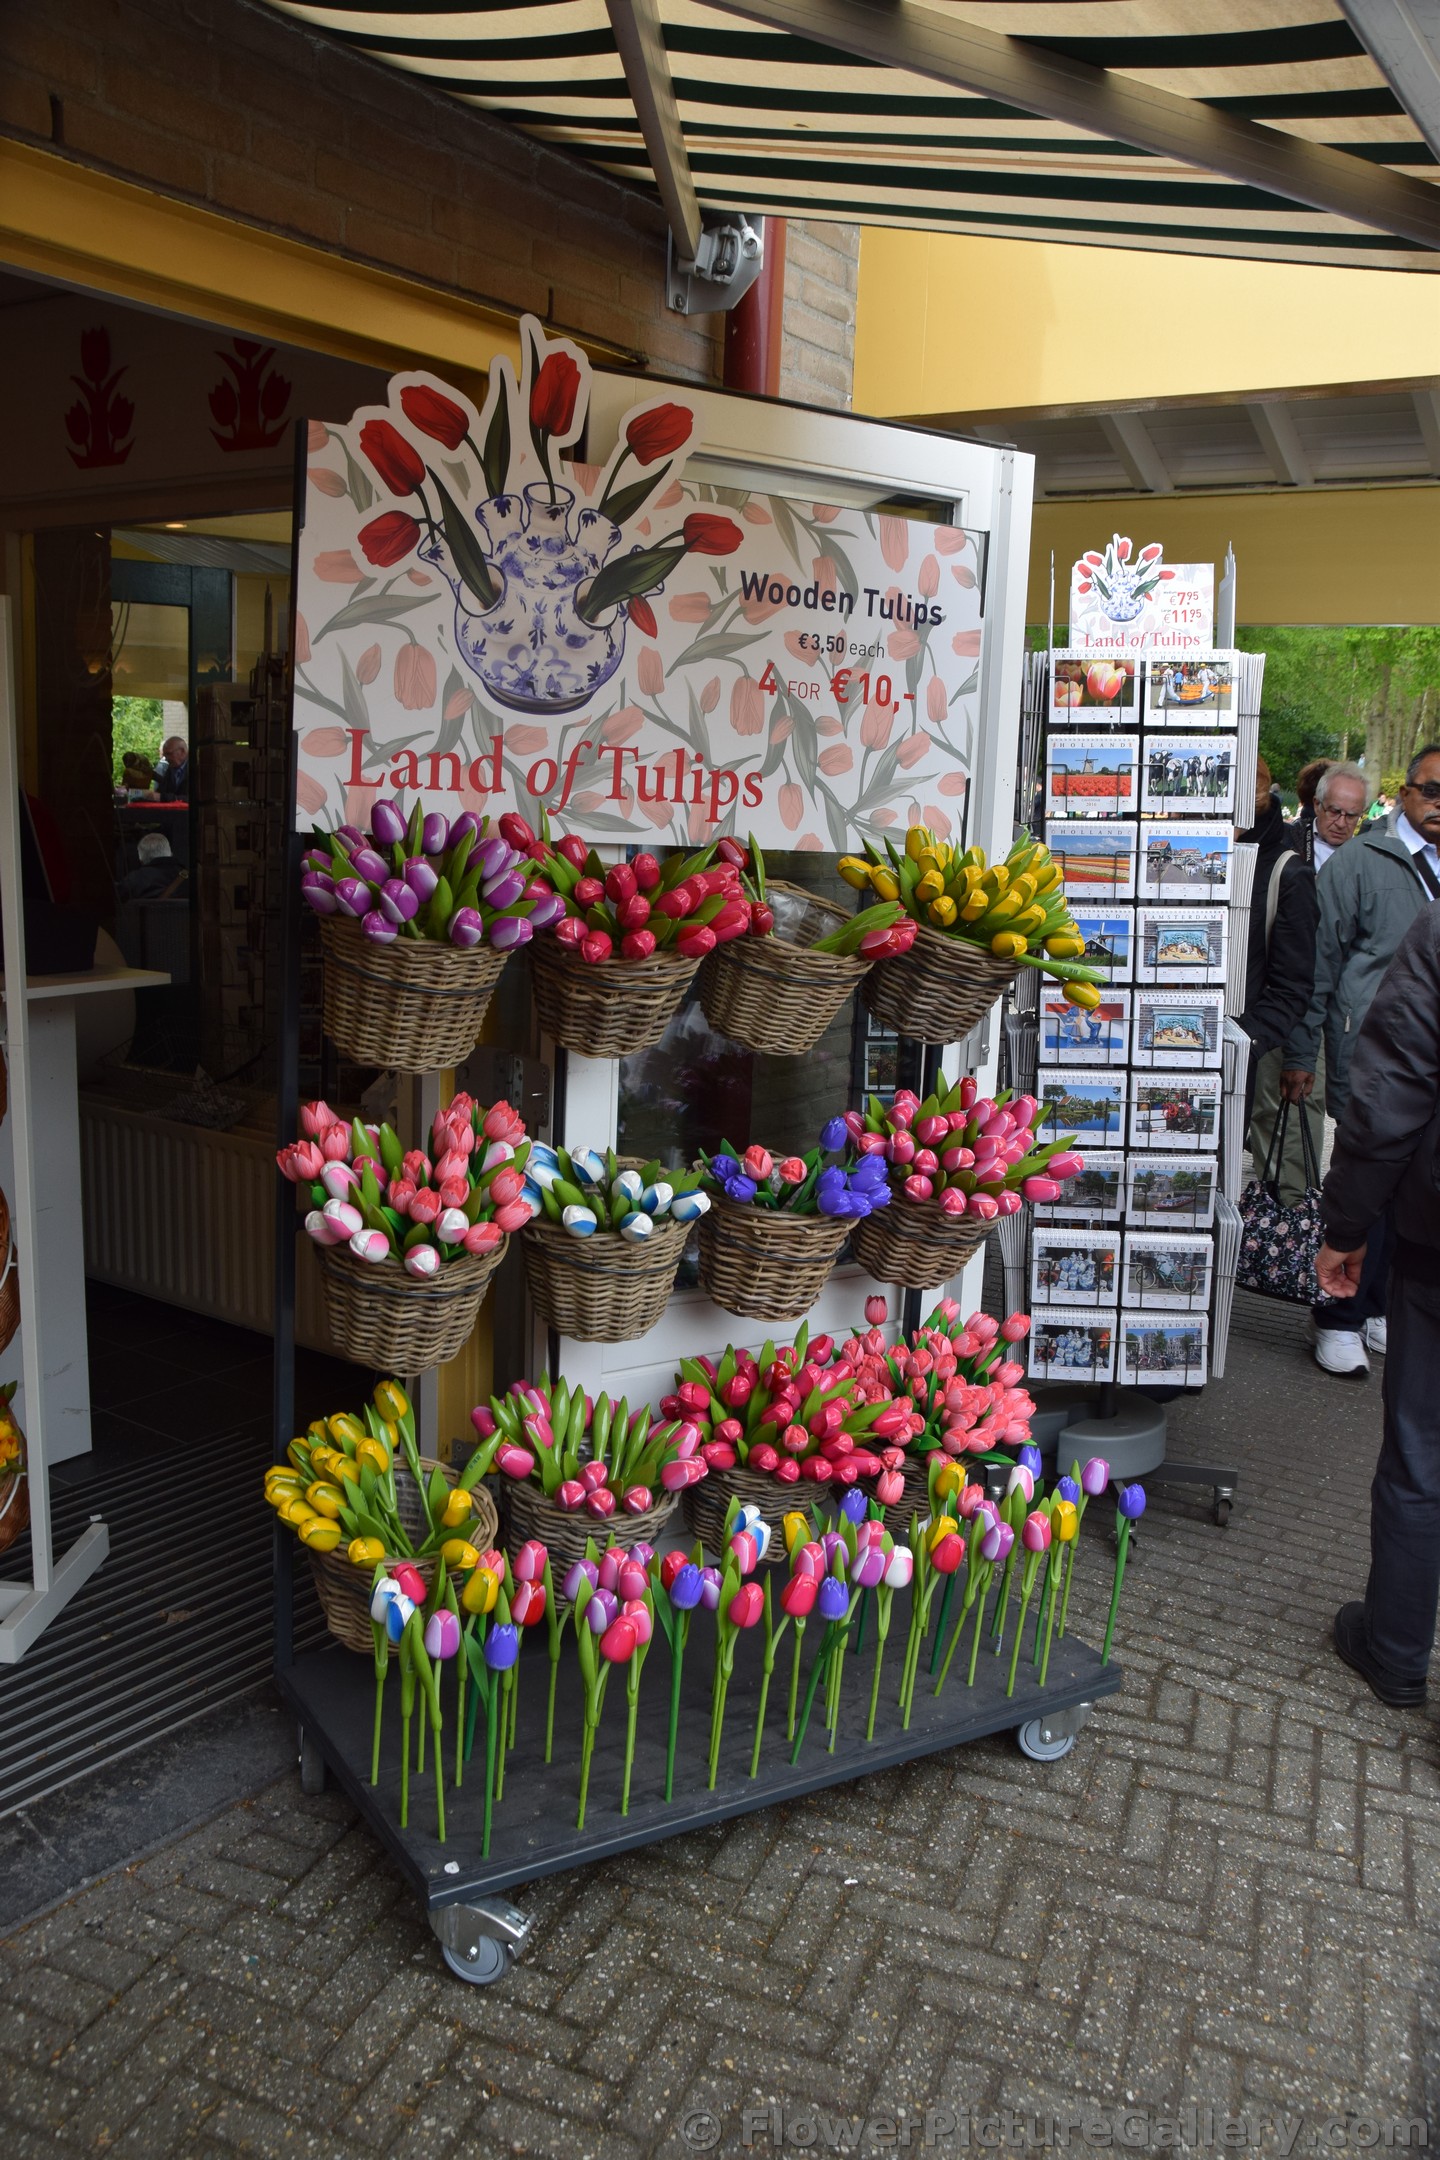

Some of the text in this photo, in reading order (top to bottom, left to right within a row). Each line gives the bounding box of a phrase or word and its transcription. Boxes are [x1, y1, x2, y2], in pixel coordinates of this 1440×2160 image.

[740, 570, 943, 631] Wooden Tulips
[798, 633, 885, 659] €3,50 each
[1084, 631, 1201, 650] Land of Tulips
[758, 662, 778, 696] 4
[787, 680, 820, 700] FOR
[343, 728, 764, 823] Land of Tulips
[1044, 1319, 1104, 1327] HOLLAND
